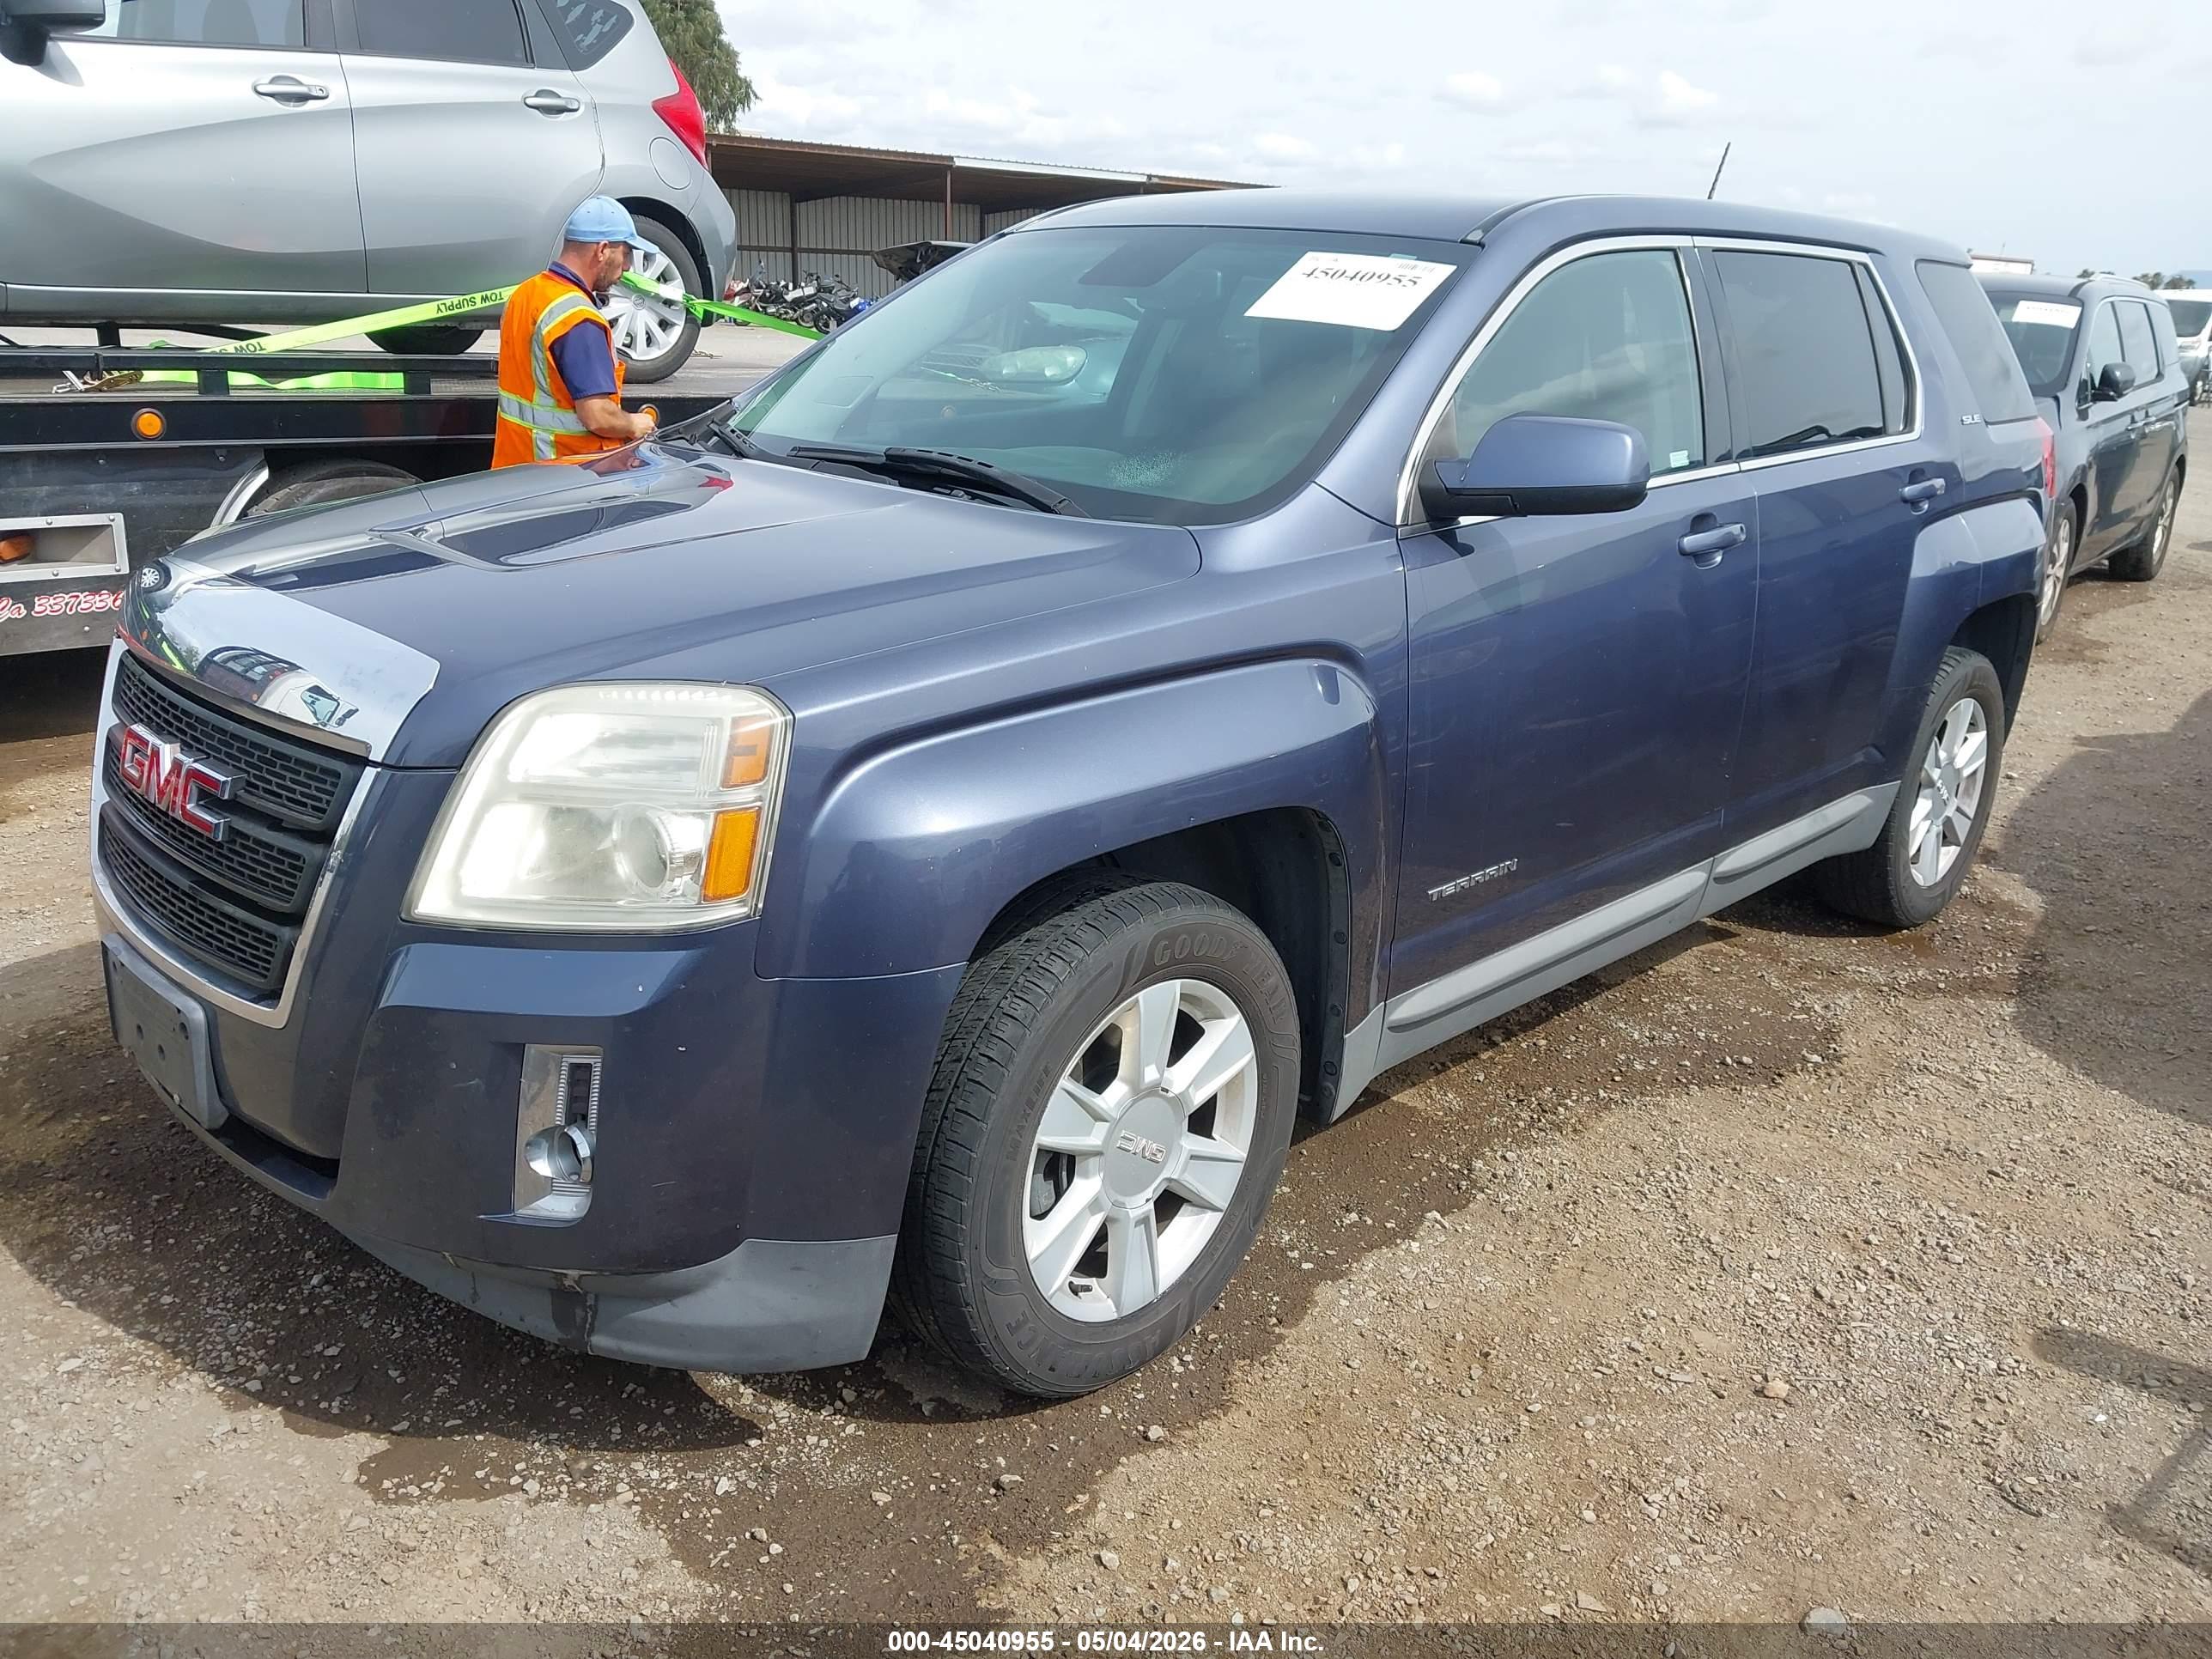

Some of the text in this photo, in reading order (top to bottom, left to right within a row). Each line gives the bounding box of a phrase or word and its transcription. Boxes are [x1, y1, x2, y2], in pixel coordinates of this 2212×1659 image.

[1116, 270, 1166, 306] GMC
[1302, 267, 1422, 288] 45040955
[436, 291, 504, 314] TOW SUPPLY
[1961, 413, 1982, 426] SLE
[119, 722, 239, 842] GMC
[1427, 858, 1518, 902] TERRAIN
